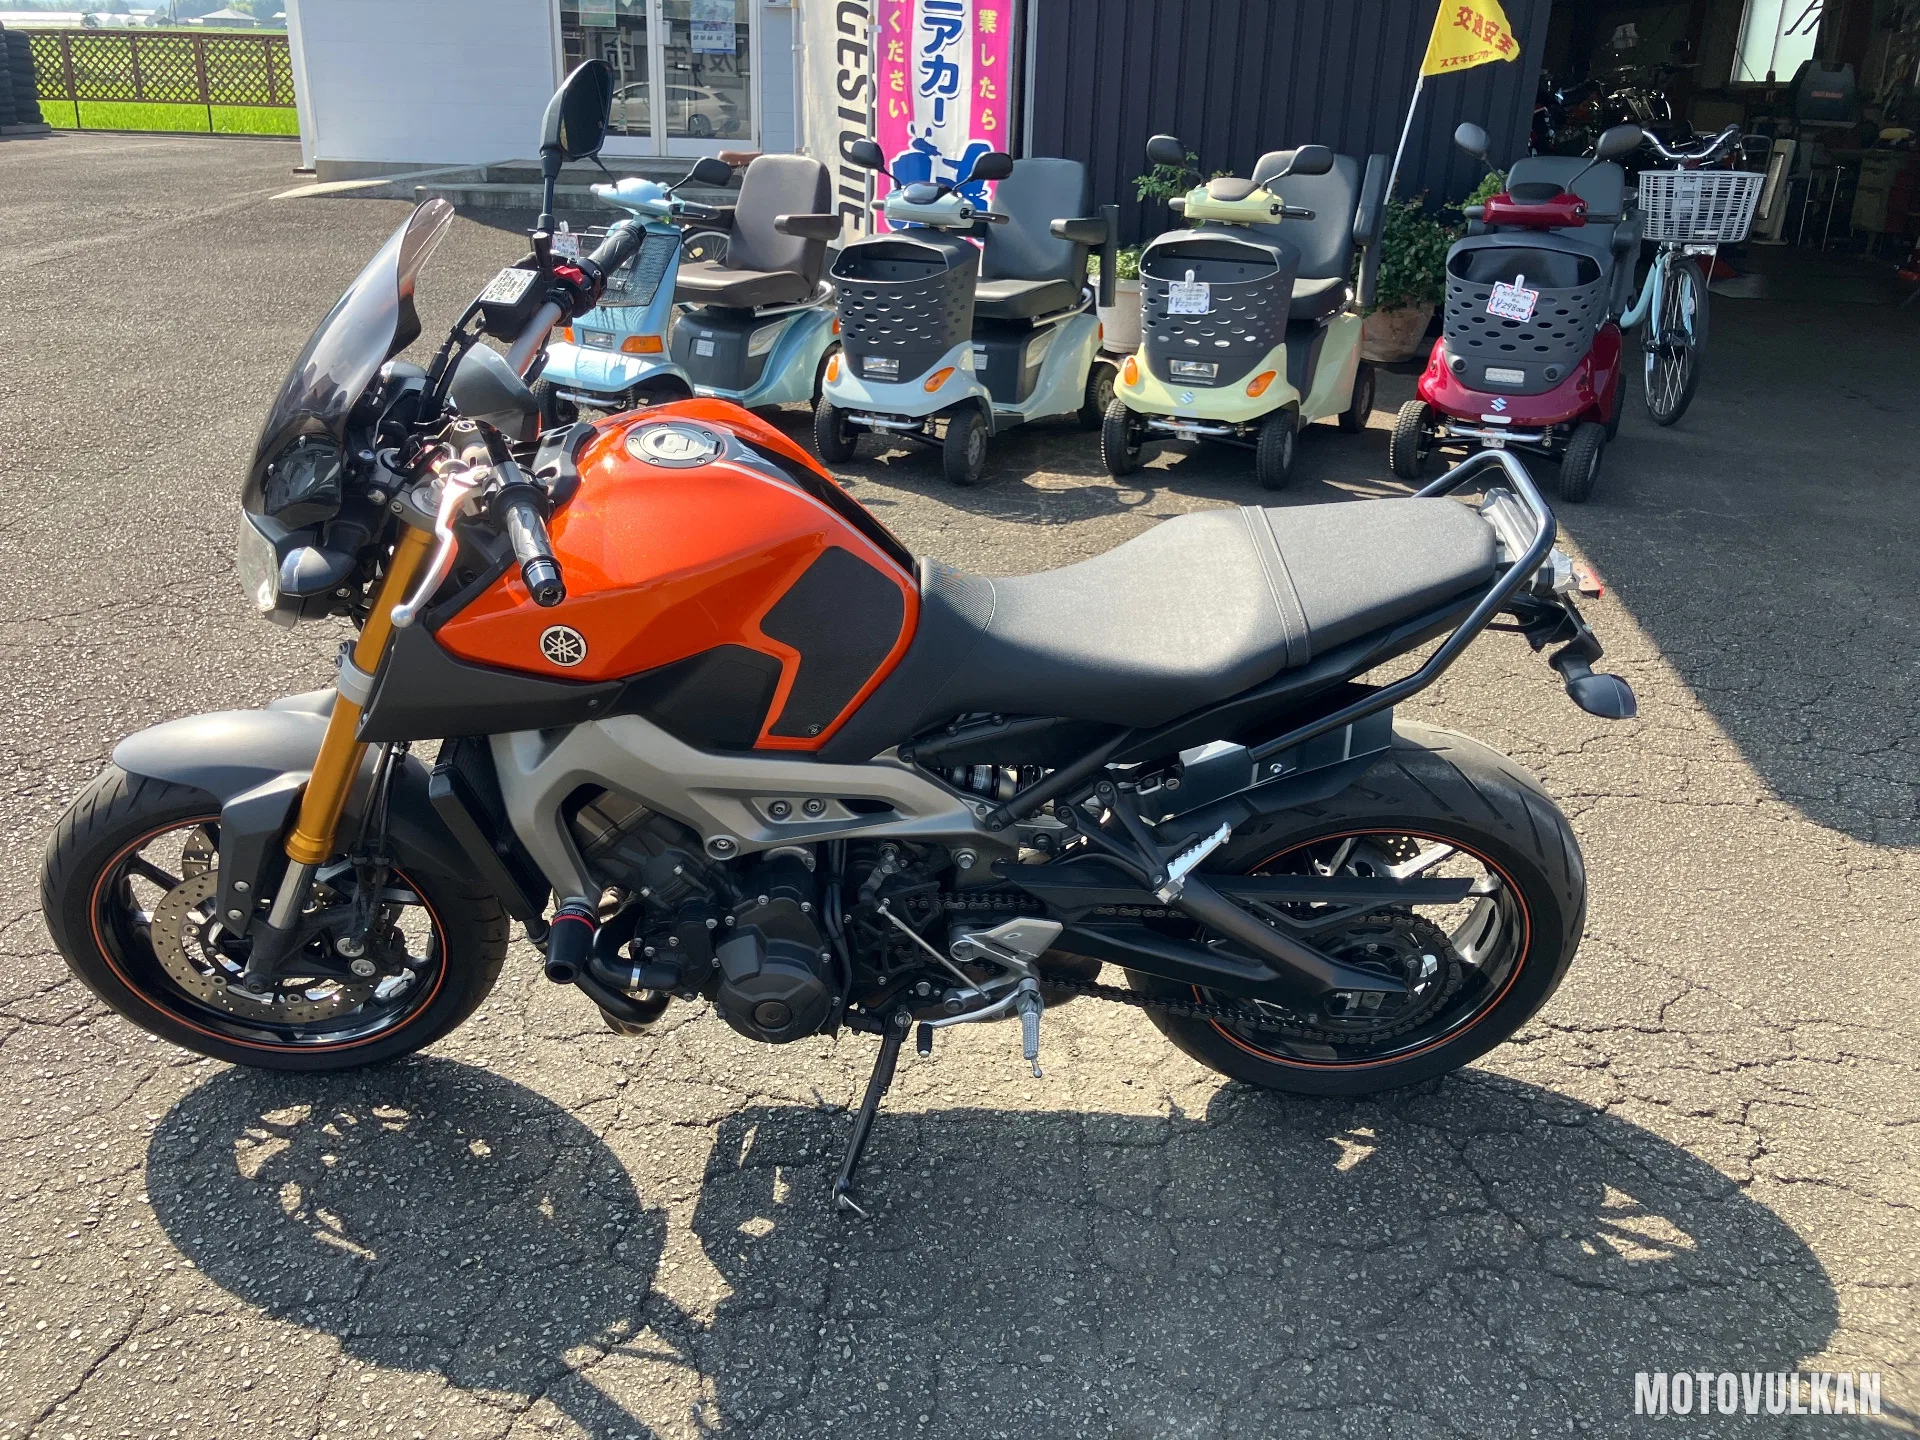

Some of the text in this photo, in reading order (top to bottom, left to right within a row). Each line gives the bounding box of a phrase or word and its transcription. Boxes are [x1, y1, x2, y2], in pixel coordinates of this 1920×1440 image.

[888, 0, 909, 118] ください
[979, 9, 998, 131] 業したら
[1453, 6, 1514, 55] 交通安全
[836, 0, 877, 235] GESTONE
